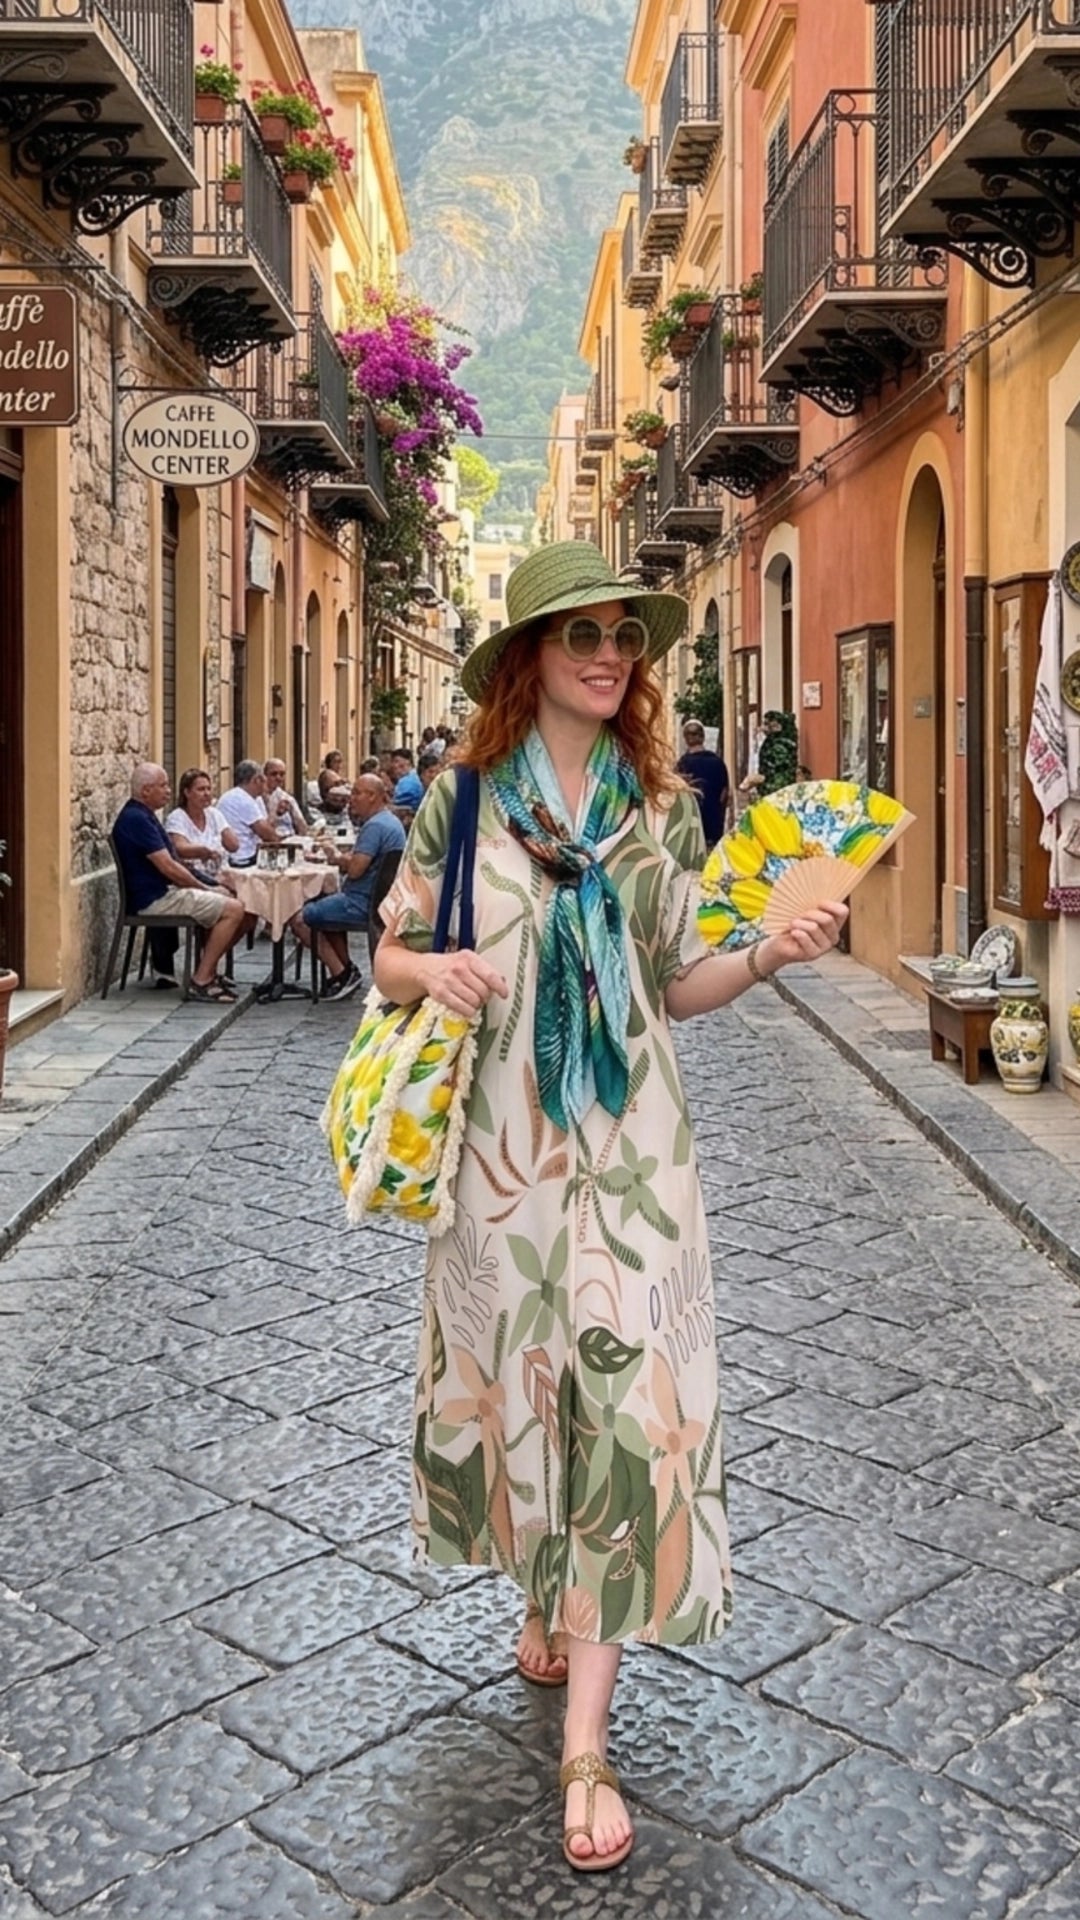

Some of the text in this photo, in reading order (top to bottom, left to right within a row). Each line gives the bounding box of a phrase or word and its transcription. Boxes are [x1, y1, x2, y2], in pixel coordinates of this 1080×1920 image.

[165, 405, 215, 422] CAFFE
[131, 428, 249, 450] MONDELLO
[151, 455, 230, 475] CENTER
